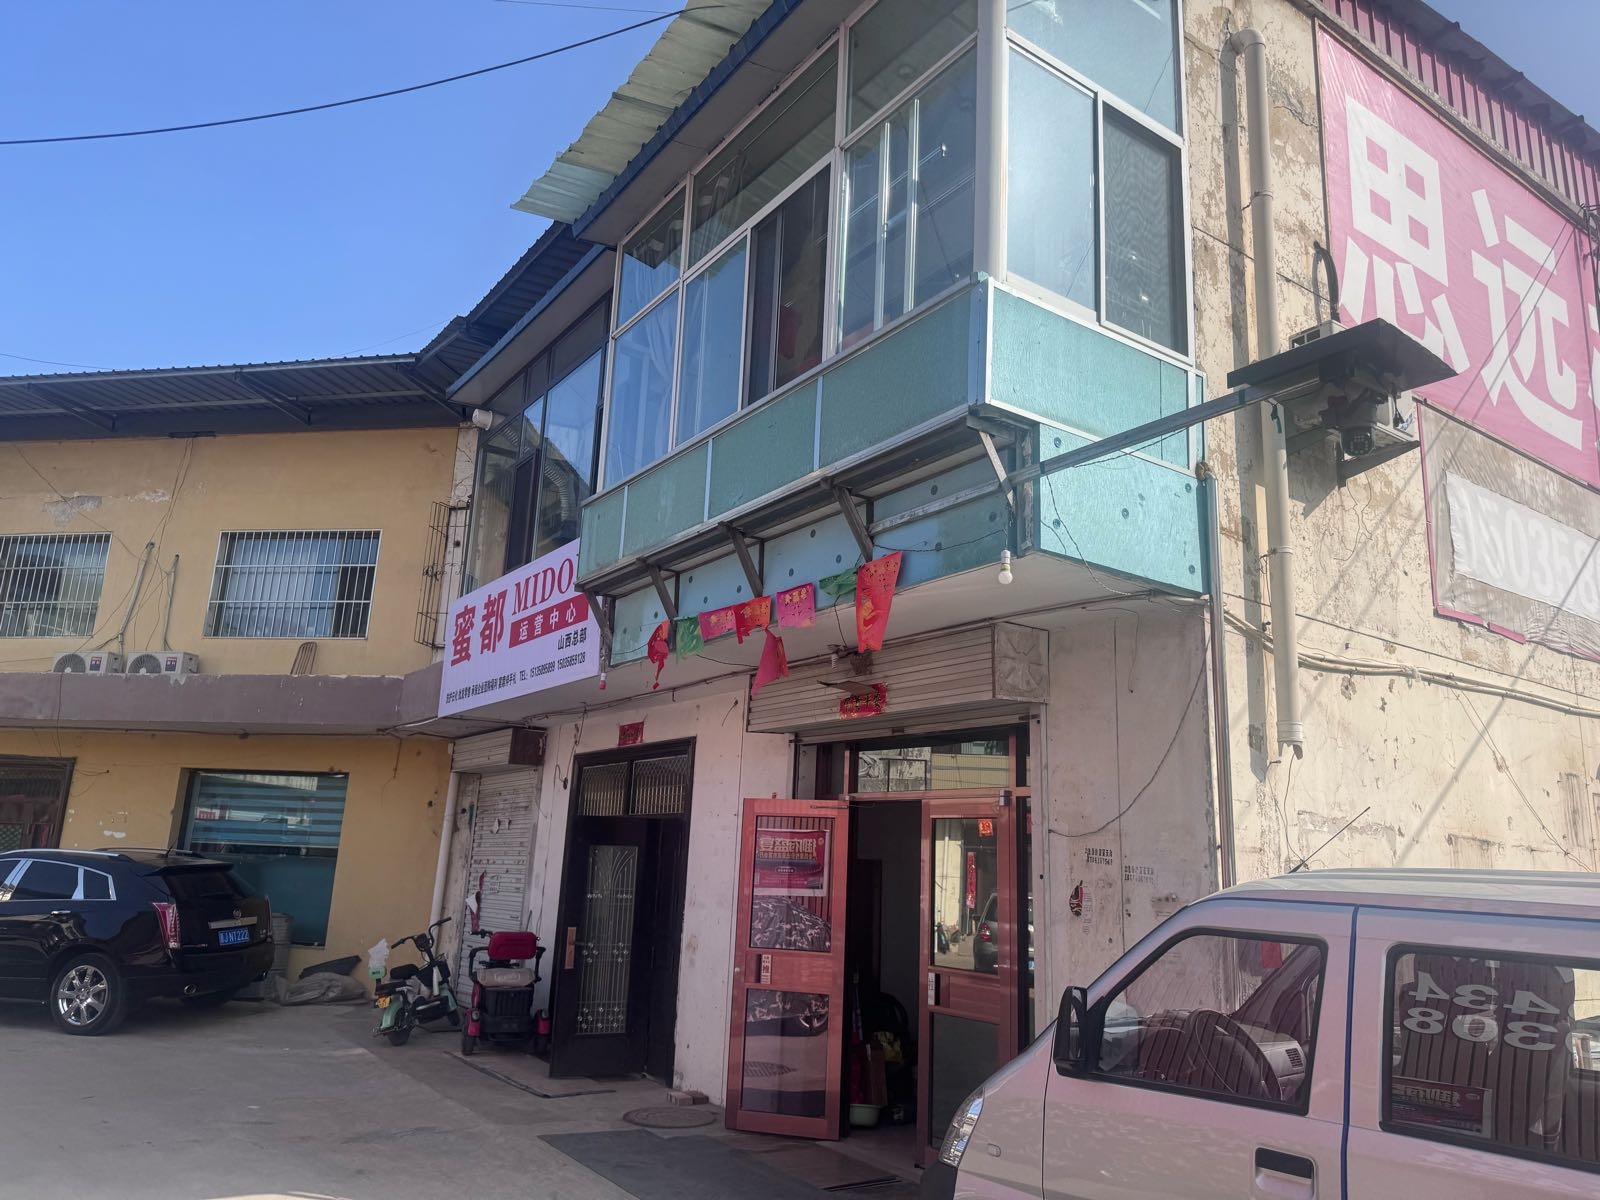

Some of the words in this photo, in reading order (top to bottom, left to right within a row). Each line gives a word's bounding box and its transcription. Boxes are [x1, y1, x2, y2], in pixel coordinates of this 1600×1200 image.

[1340, 97, 1600, 451] 思远
[1455, 484, 1600, 622] 150358
[450, 589, 508, 667] 蜜都
[512, 558, 574, 616] MIDO
[519, 602, 577, 641] 运营中心
[558, 627, 588, 651] 山西总部
